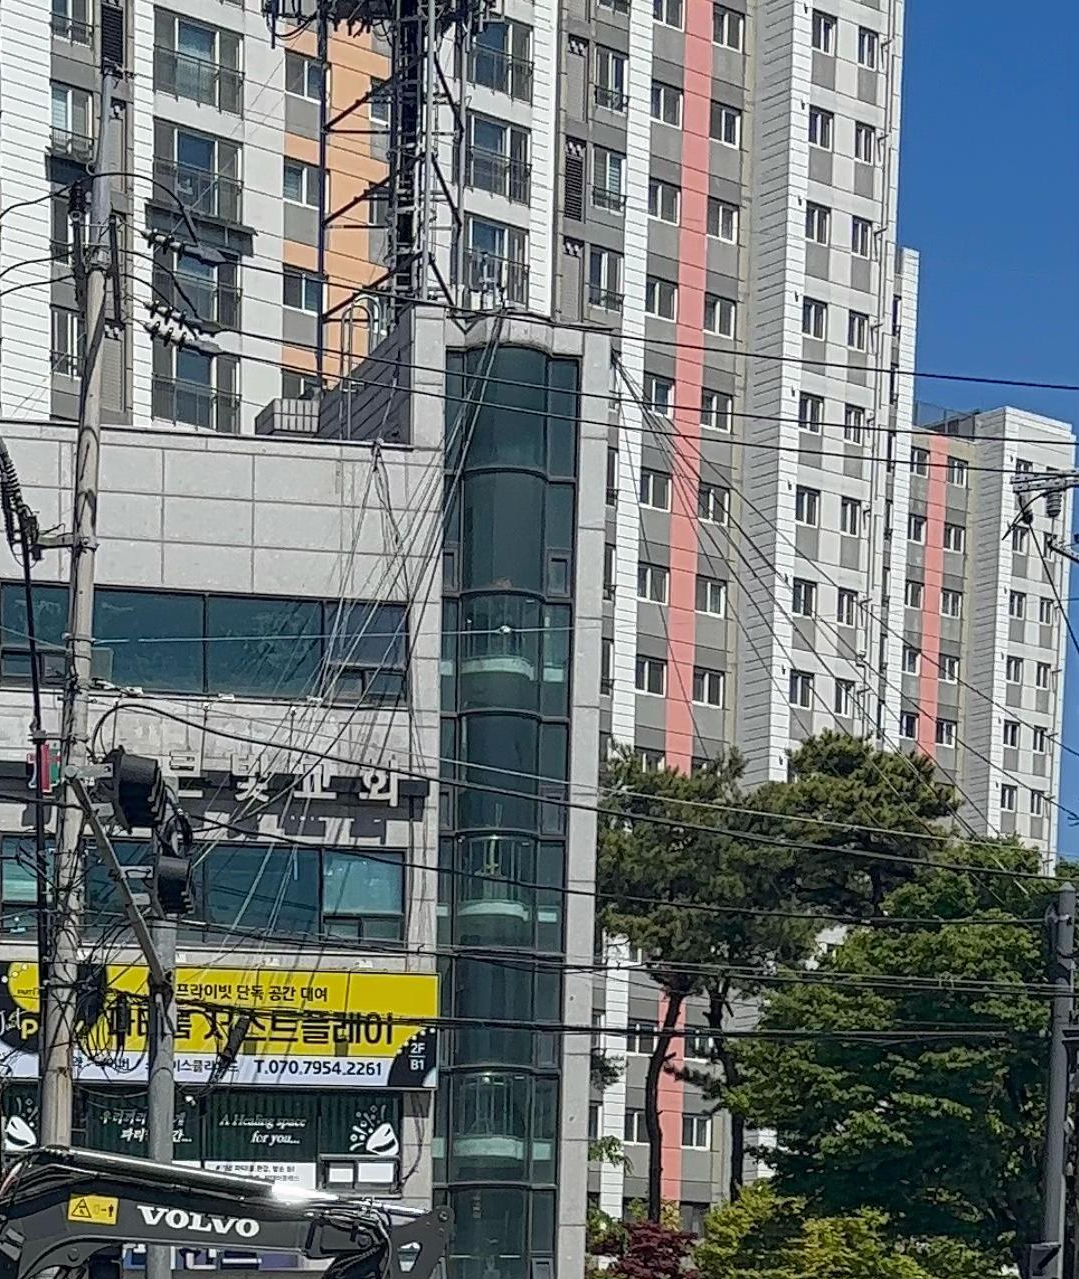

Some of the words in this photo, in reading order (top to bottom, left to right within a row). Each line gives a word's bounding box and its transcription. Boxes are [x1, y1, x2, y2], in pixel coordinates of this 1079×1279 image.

[177, 984, 232, 999] 프라이빗
[236, 985, 265, 1001] 단독
[269, 986, 296, 1001] 공간
[300, 986, 328, 1002] 대여
[410, 1042, 426, 1054] 2F
[254, 1059, 382, 1077] T.070.7954.2261
[410, 1059, 425, 1070] B1
[276, 1116, 307, 1130] space
[251, 1130, 269, 1144] for
[136, 1204, 260, 1239] VOLVO
